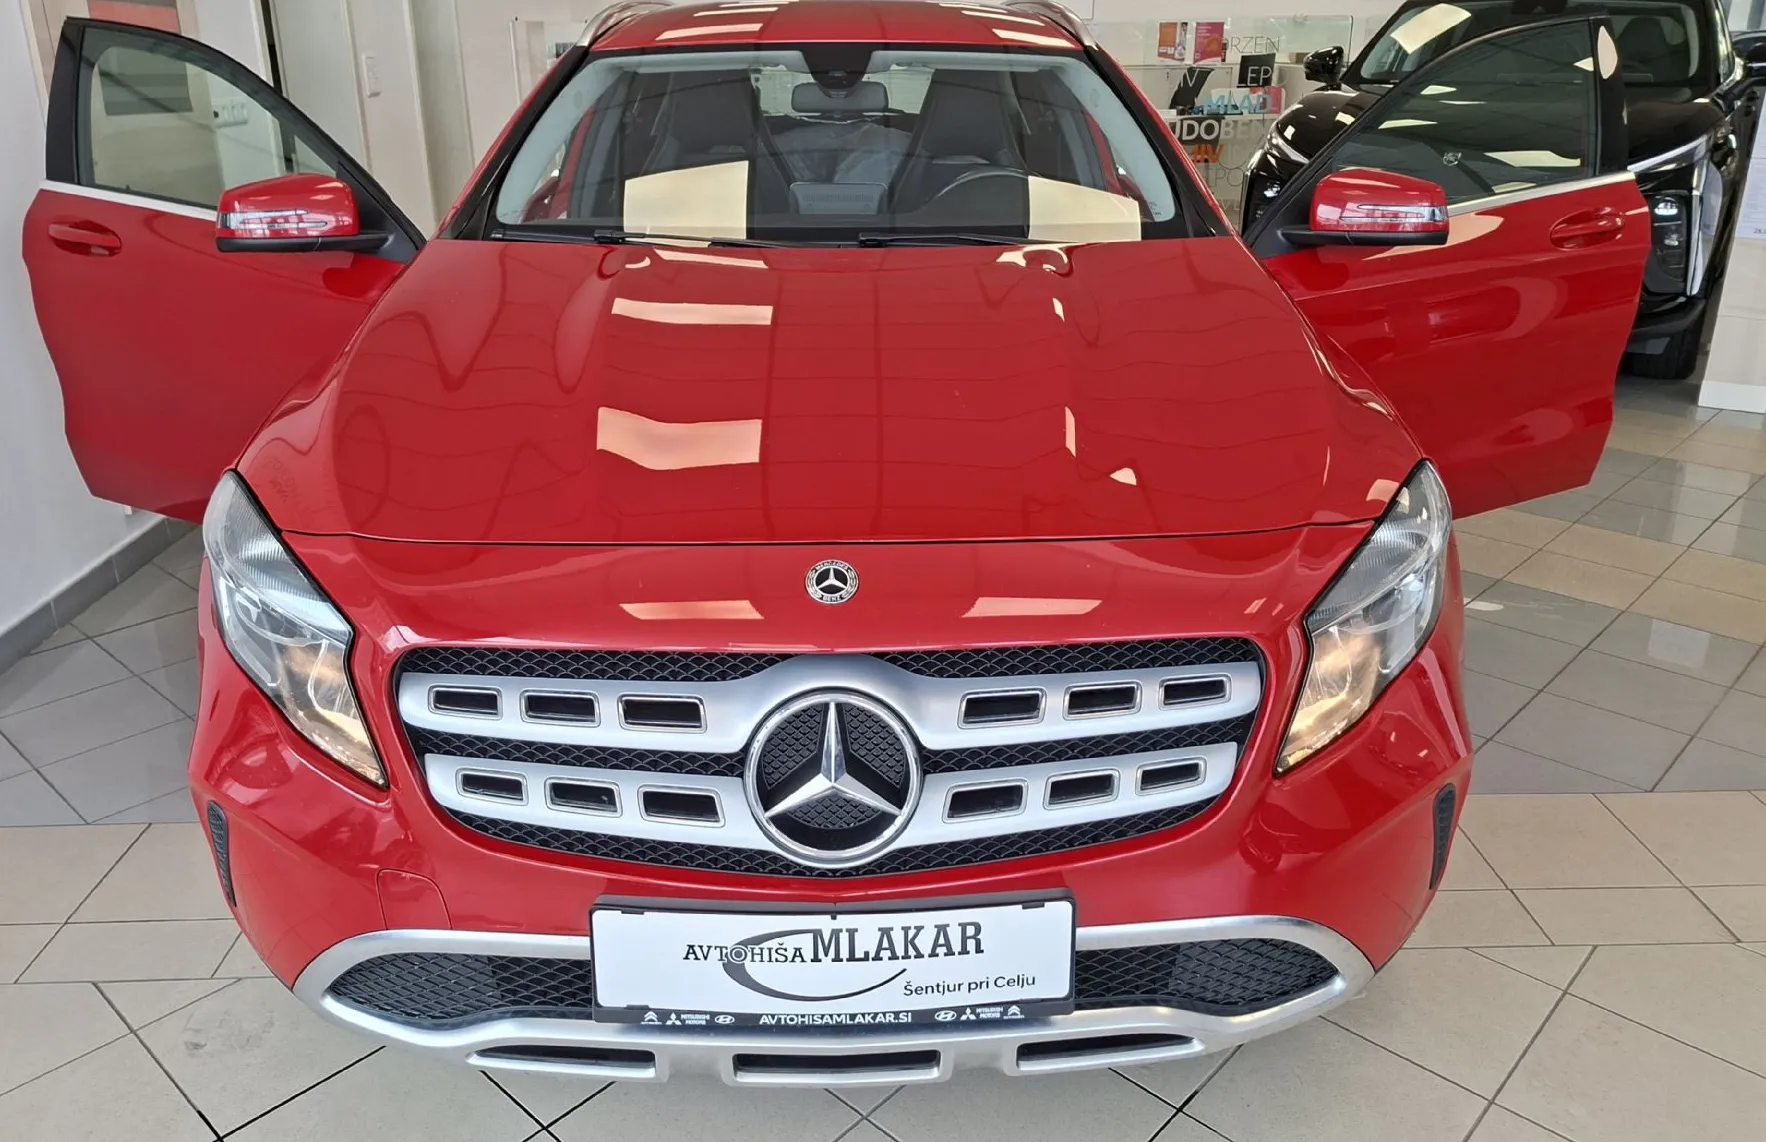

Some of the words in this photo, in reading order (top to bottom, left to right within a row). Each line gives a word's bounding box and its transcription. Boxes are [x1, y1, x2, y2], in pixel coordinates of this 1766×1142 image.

[811, 921, 985, 963] MLAKAR
[903, 980, 963, 996] Šentjur
[968, 976, 990, 993] pri
[993, 973, 1036, 989] Celju
[759, 1012, 912, 1025] AVTOHISAMLAKAR.SI
